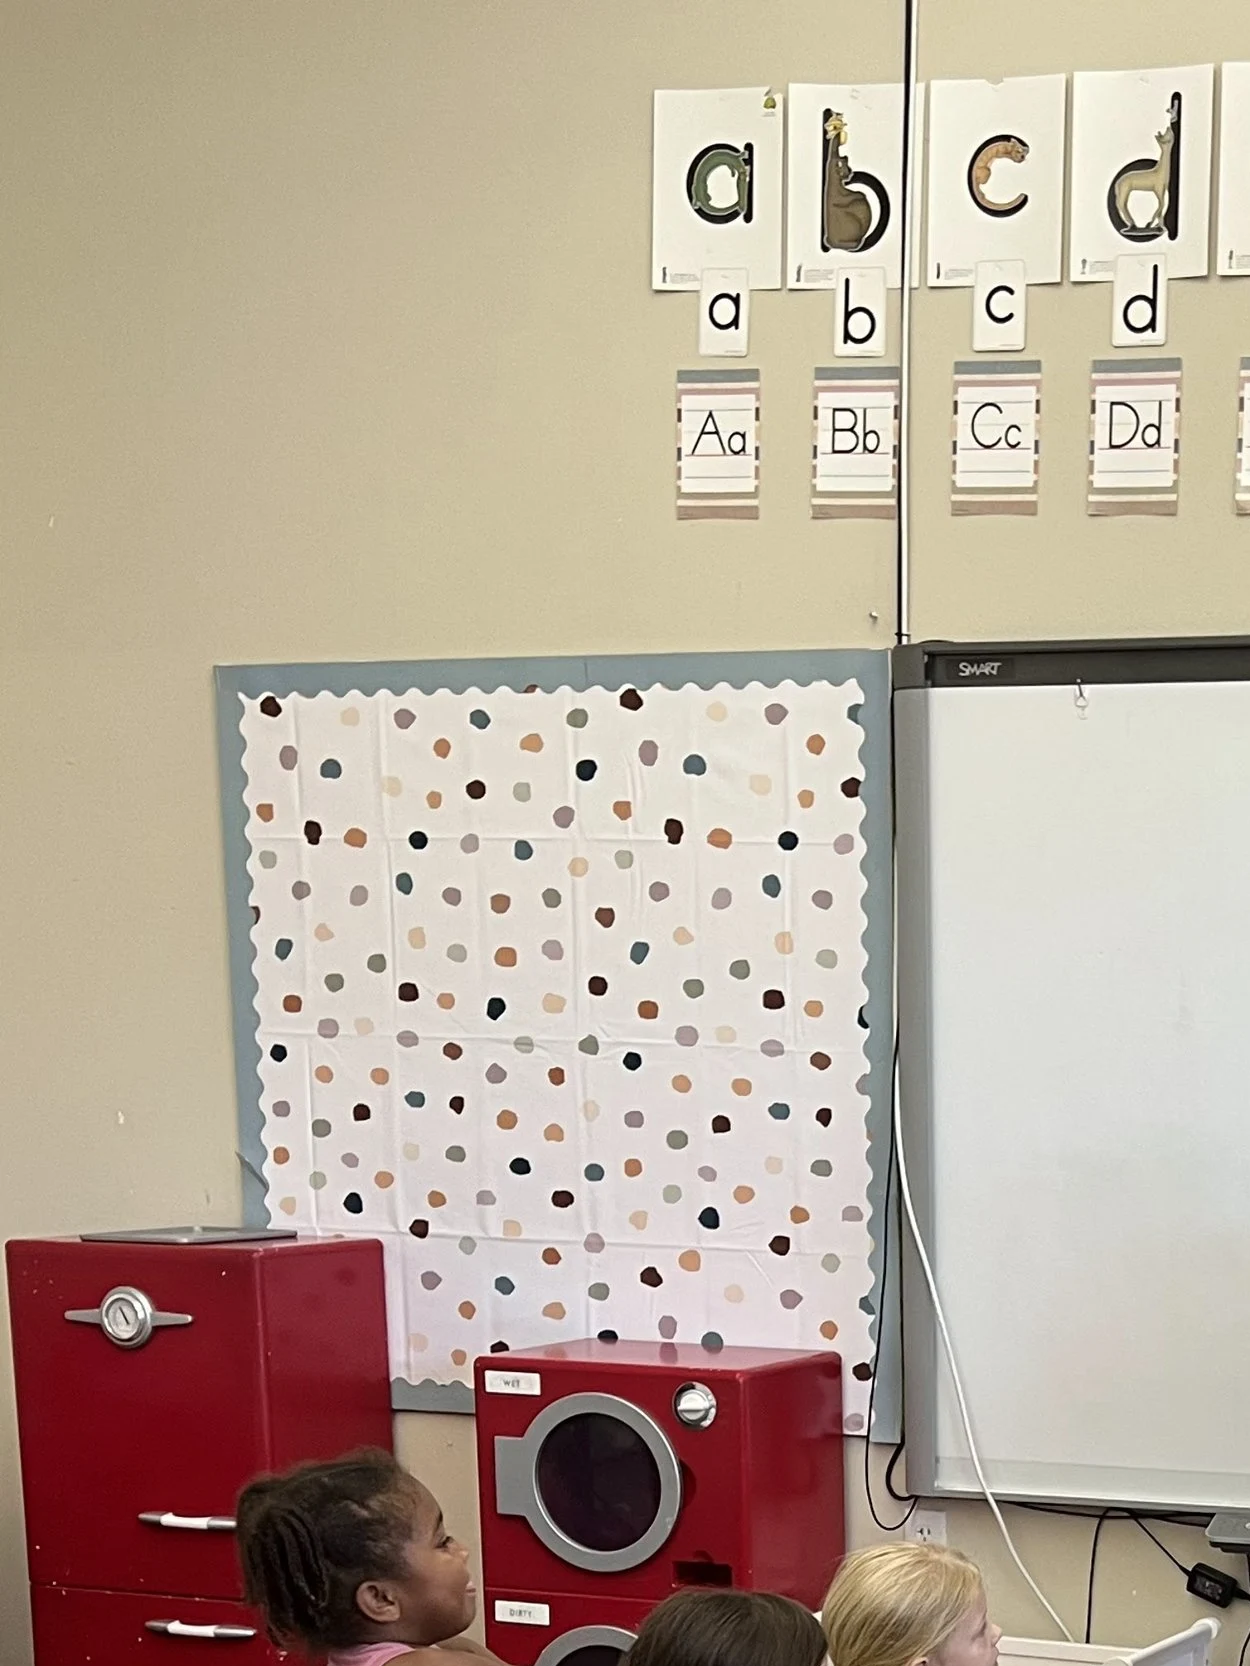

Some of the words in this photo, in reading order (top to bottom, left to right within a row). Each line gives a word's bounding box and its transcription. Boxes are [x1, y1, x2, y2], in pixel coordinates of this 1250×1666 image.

[708, 292, 741, 331] a
[843, 277, 876, 345] b
[985, 285, 1015, 324] c
[1122, 263, 1159, 334] d
[691, 410, 747, 456] Aa
[831, 407, 880, 454] Bb
[971, 402, 1022, 450] Cc
[1108, 400, 1163, 450] Dd
[958, 662, 1002, 676] SMART
